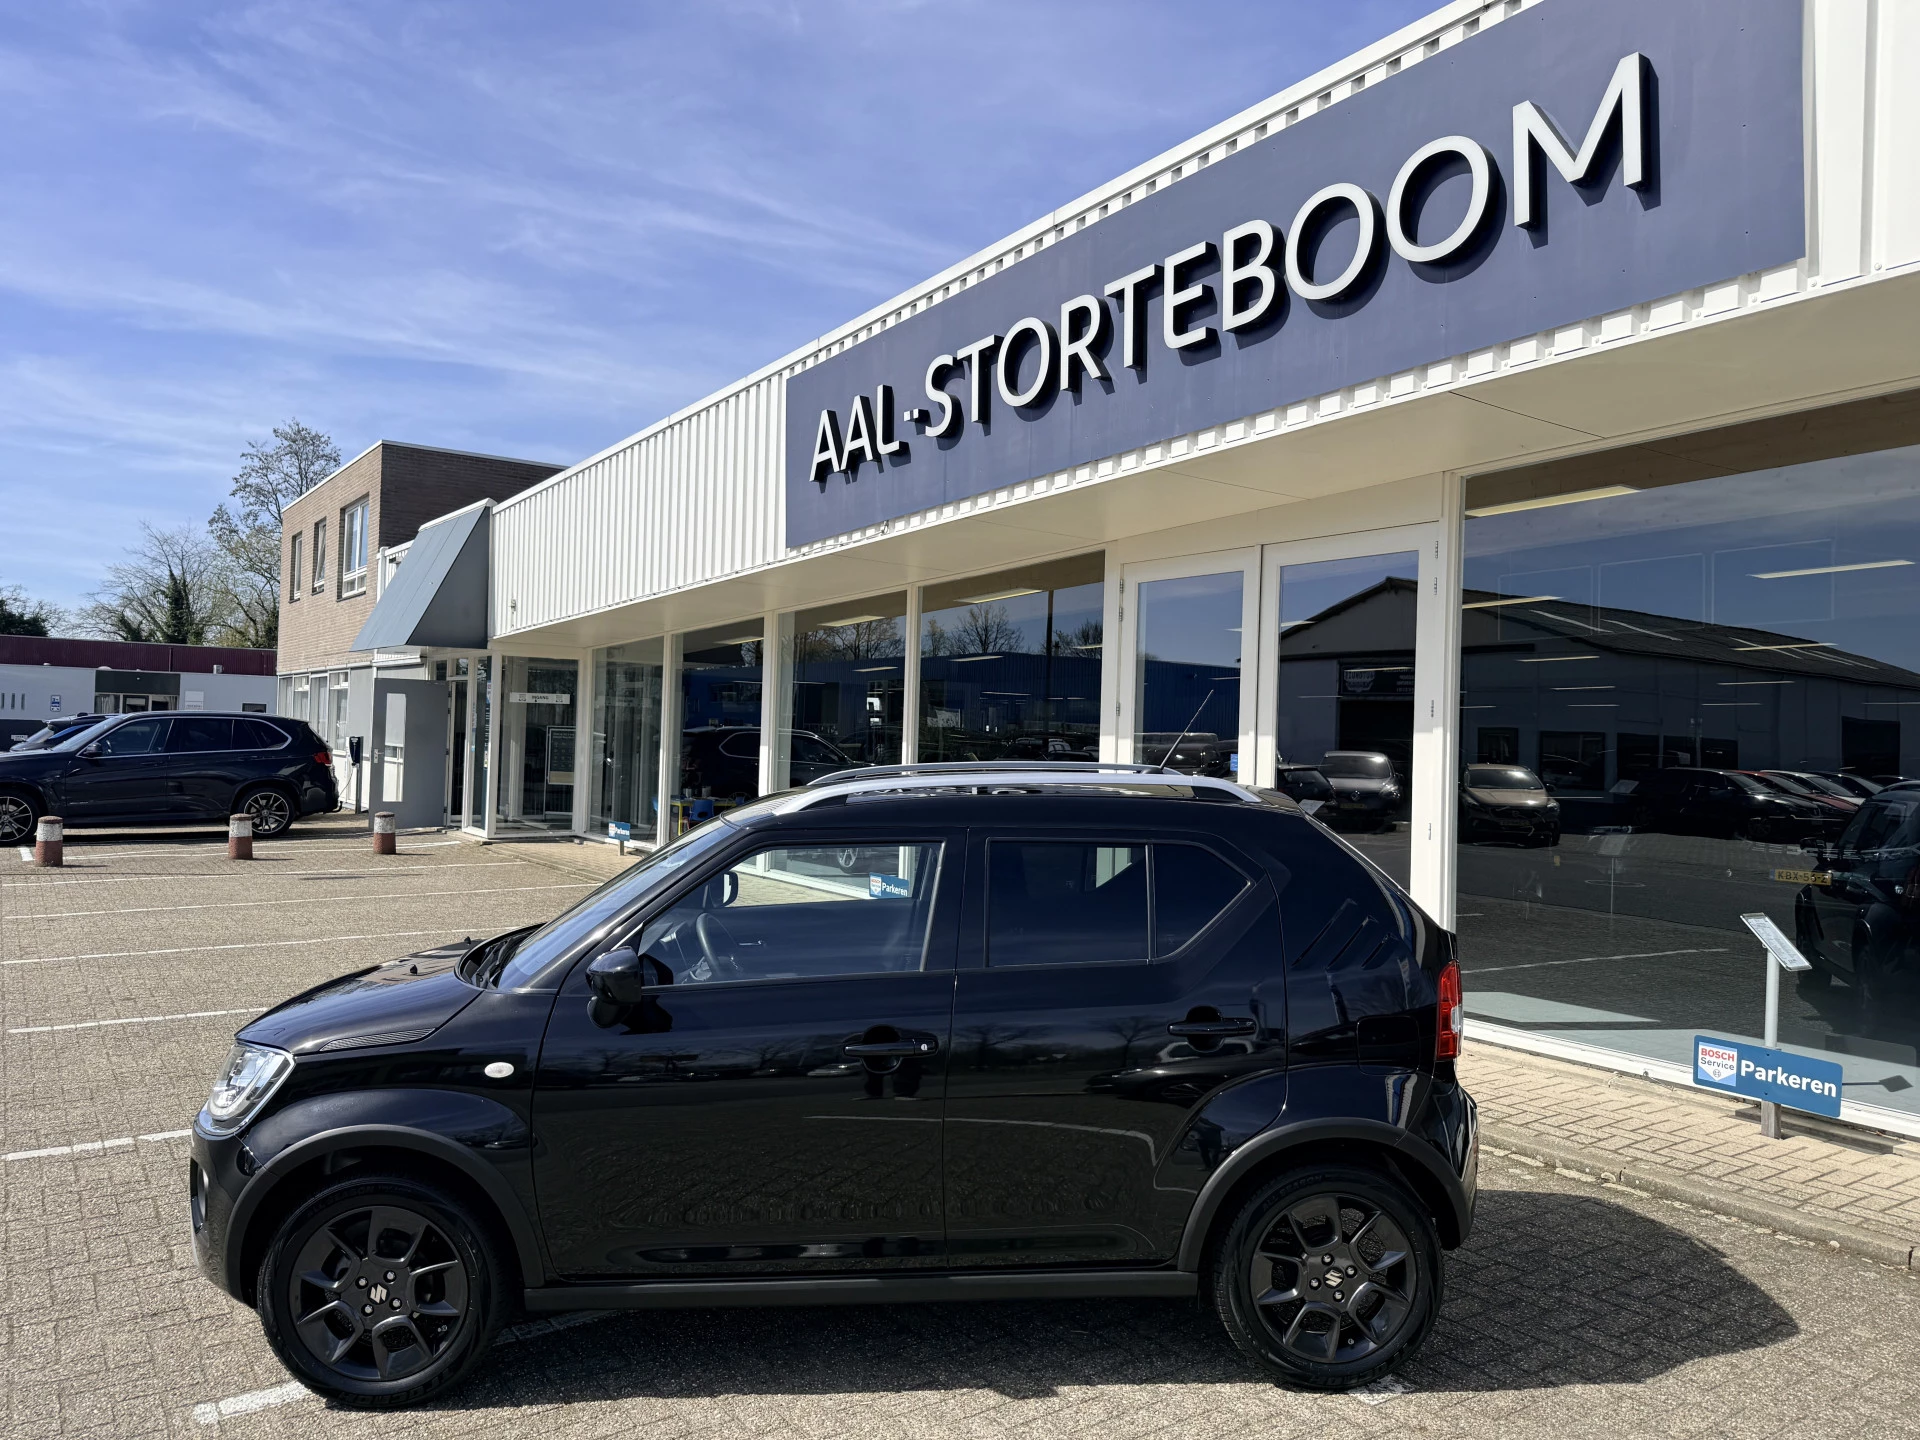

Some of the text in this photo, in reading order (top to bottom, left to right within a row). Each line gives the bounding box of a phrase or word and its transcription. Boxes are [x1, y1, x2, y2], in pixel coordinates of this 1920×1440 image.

[882, 883, 907, 896] Parkeren
[1700, 1047, 1735, 1062] BOSCH
[1700, 1056, 1735, 1071] Service
[1740, 1059, 1837, 1098] Parkeren
